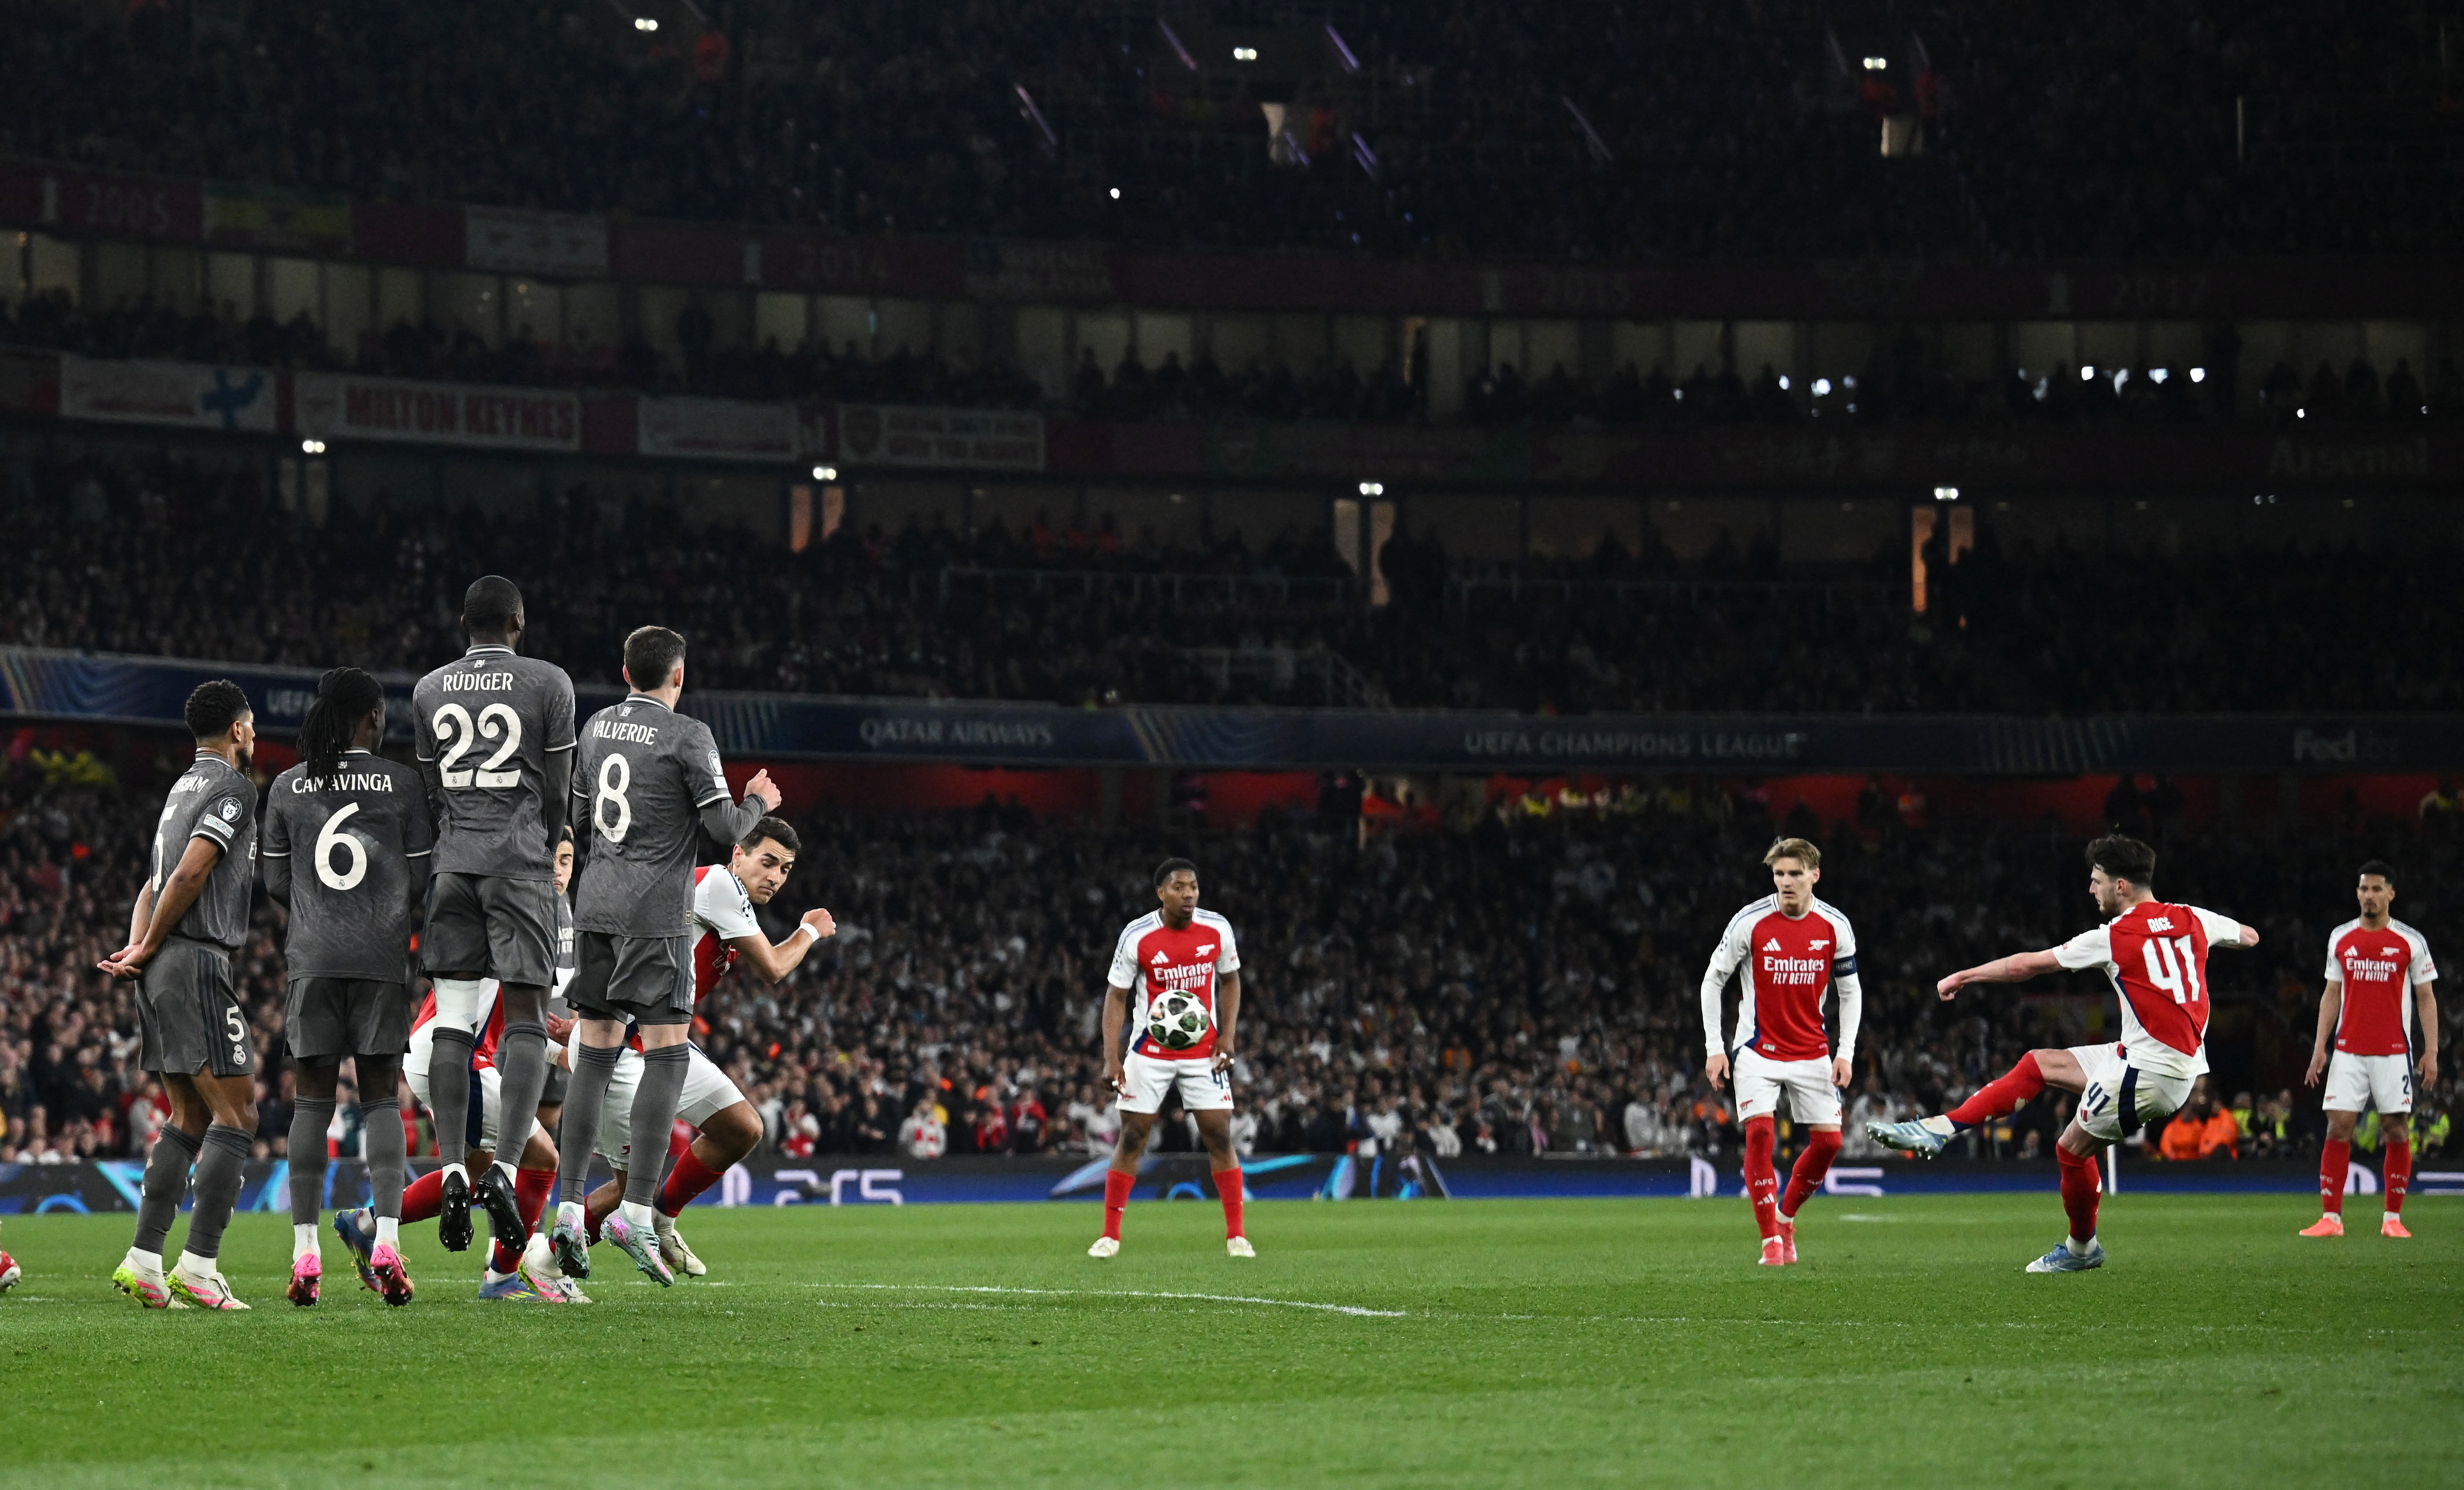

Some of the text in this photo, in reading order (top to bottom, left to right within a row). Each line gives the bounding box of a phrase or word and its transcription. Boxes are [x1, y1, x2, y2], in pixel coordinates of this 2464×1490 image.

[85, 182, 171, 235] 2005
[2109, 271, 2208, 312] 2017
[346, 384, 575, 442] MILTON KEYNES
[2266, 434, 2429, 477] Arsenal
[443, 671, 513, 692] RÜDIGER
[432, 703, 522, 787] 22
[592, 720, 658, 745] VALVERDE
[859, 718, 1054, 748] QATAR AIRWAYS
[1464, 731, 1803, 760] UEFA CHAMPIONS LEAGUE
[594, 753, 631, 843] 8
[206, 817, 232, 836] FOUNDATION
[315, 802, 367, 890] 6
[2147, 916, 2174, 933] RICE
[1153, 961, 1213, 981] Emirates
[1763, 956, 1824, 972] Emirates
[1773, 972, 1788, 985] FLY
[2142, 934, 2200, 1004] 41
[2346, 957, 2397, 973] Emirates
[226, 1005, 245, 1042] 5
[2087, 1082, 2111, 1117] 41
[2402, 1075, 2410, 1095] 2
